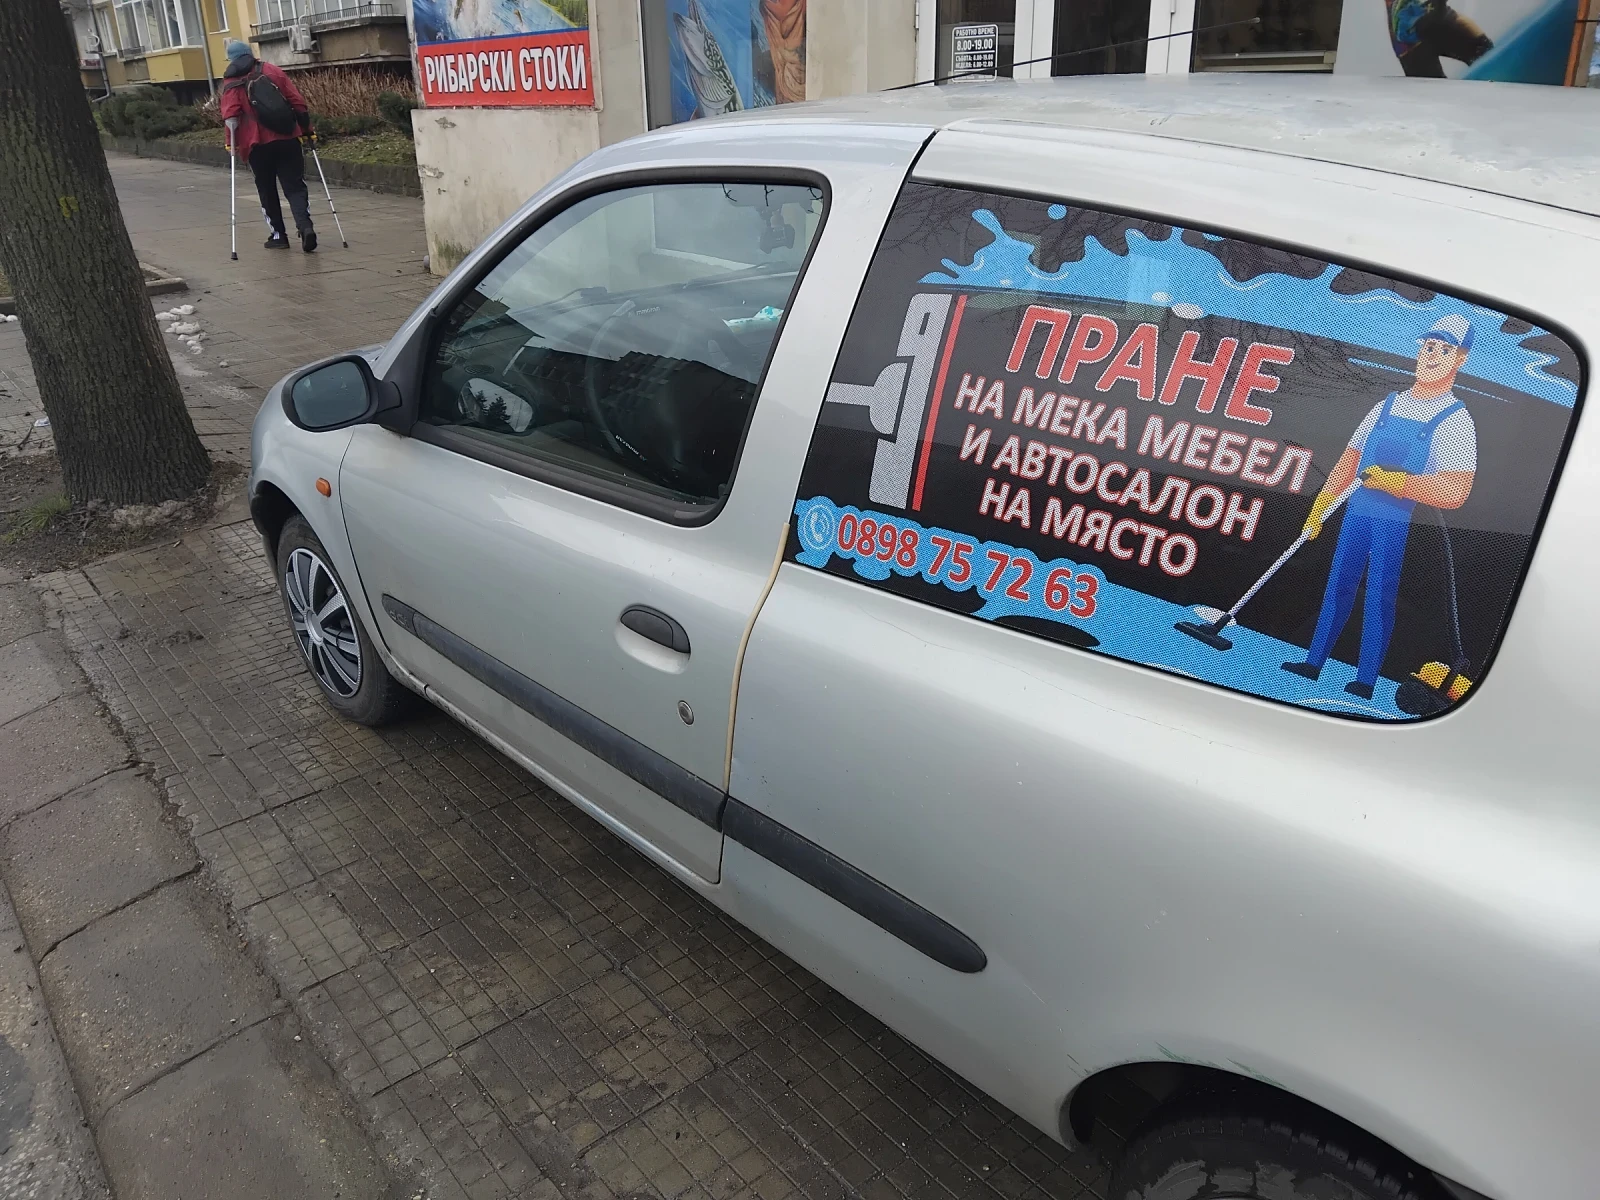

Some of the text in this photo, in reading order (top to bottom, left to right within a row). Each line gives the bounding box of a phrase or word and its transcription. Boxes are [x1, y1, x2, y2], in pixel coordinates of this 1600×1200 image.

[424, 44, 587, 94] РИБАРСКИ СТОКИ
[956, 38, 993, 51] 8.00-19.00
[1005, 304, 1295, 426] ПРАНЕ
[953, 372, 1314, 494] НА МЕКА МЕБЕЛ
[958, 423, 1265, 542] И АВТОСАЛОН
[837, 512, 1099, 619] 0898 75 72 63
[978, 477, 1199, 577] НА МЯСТО
